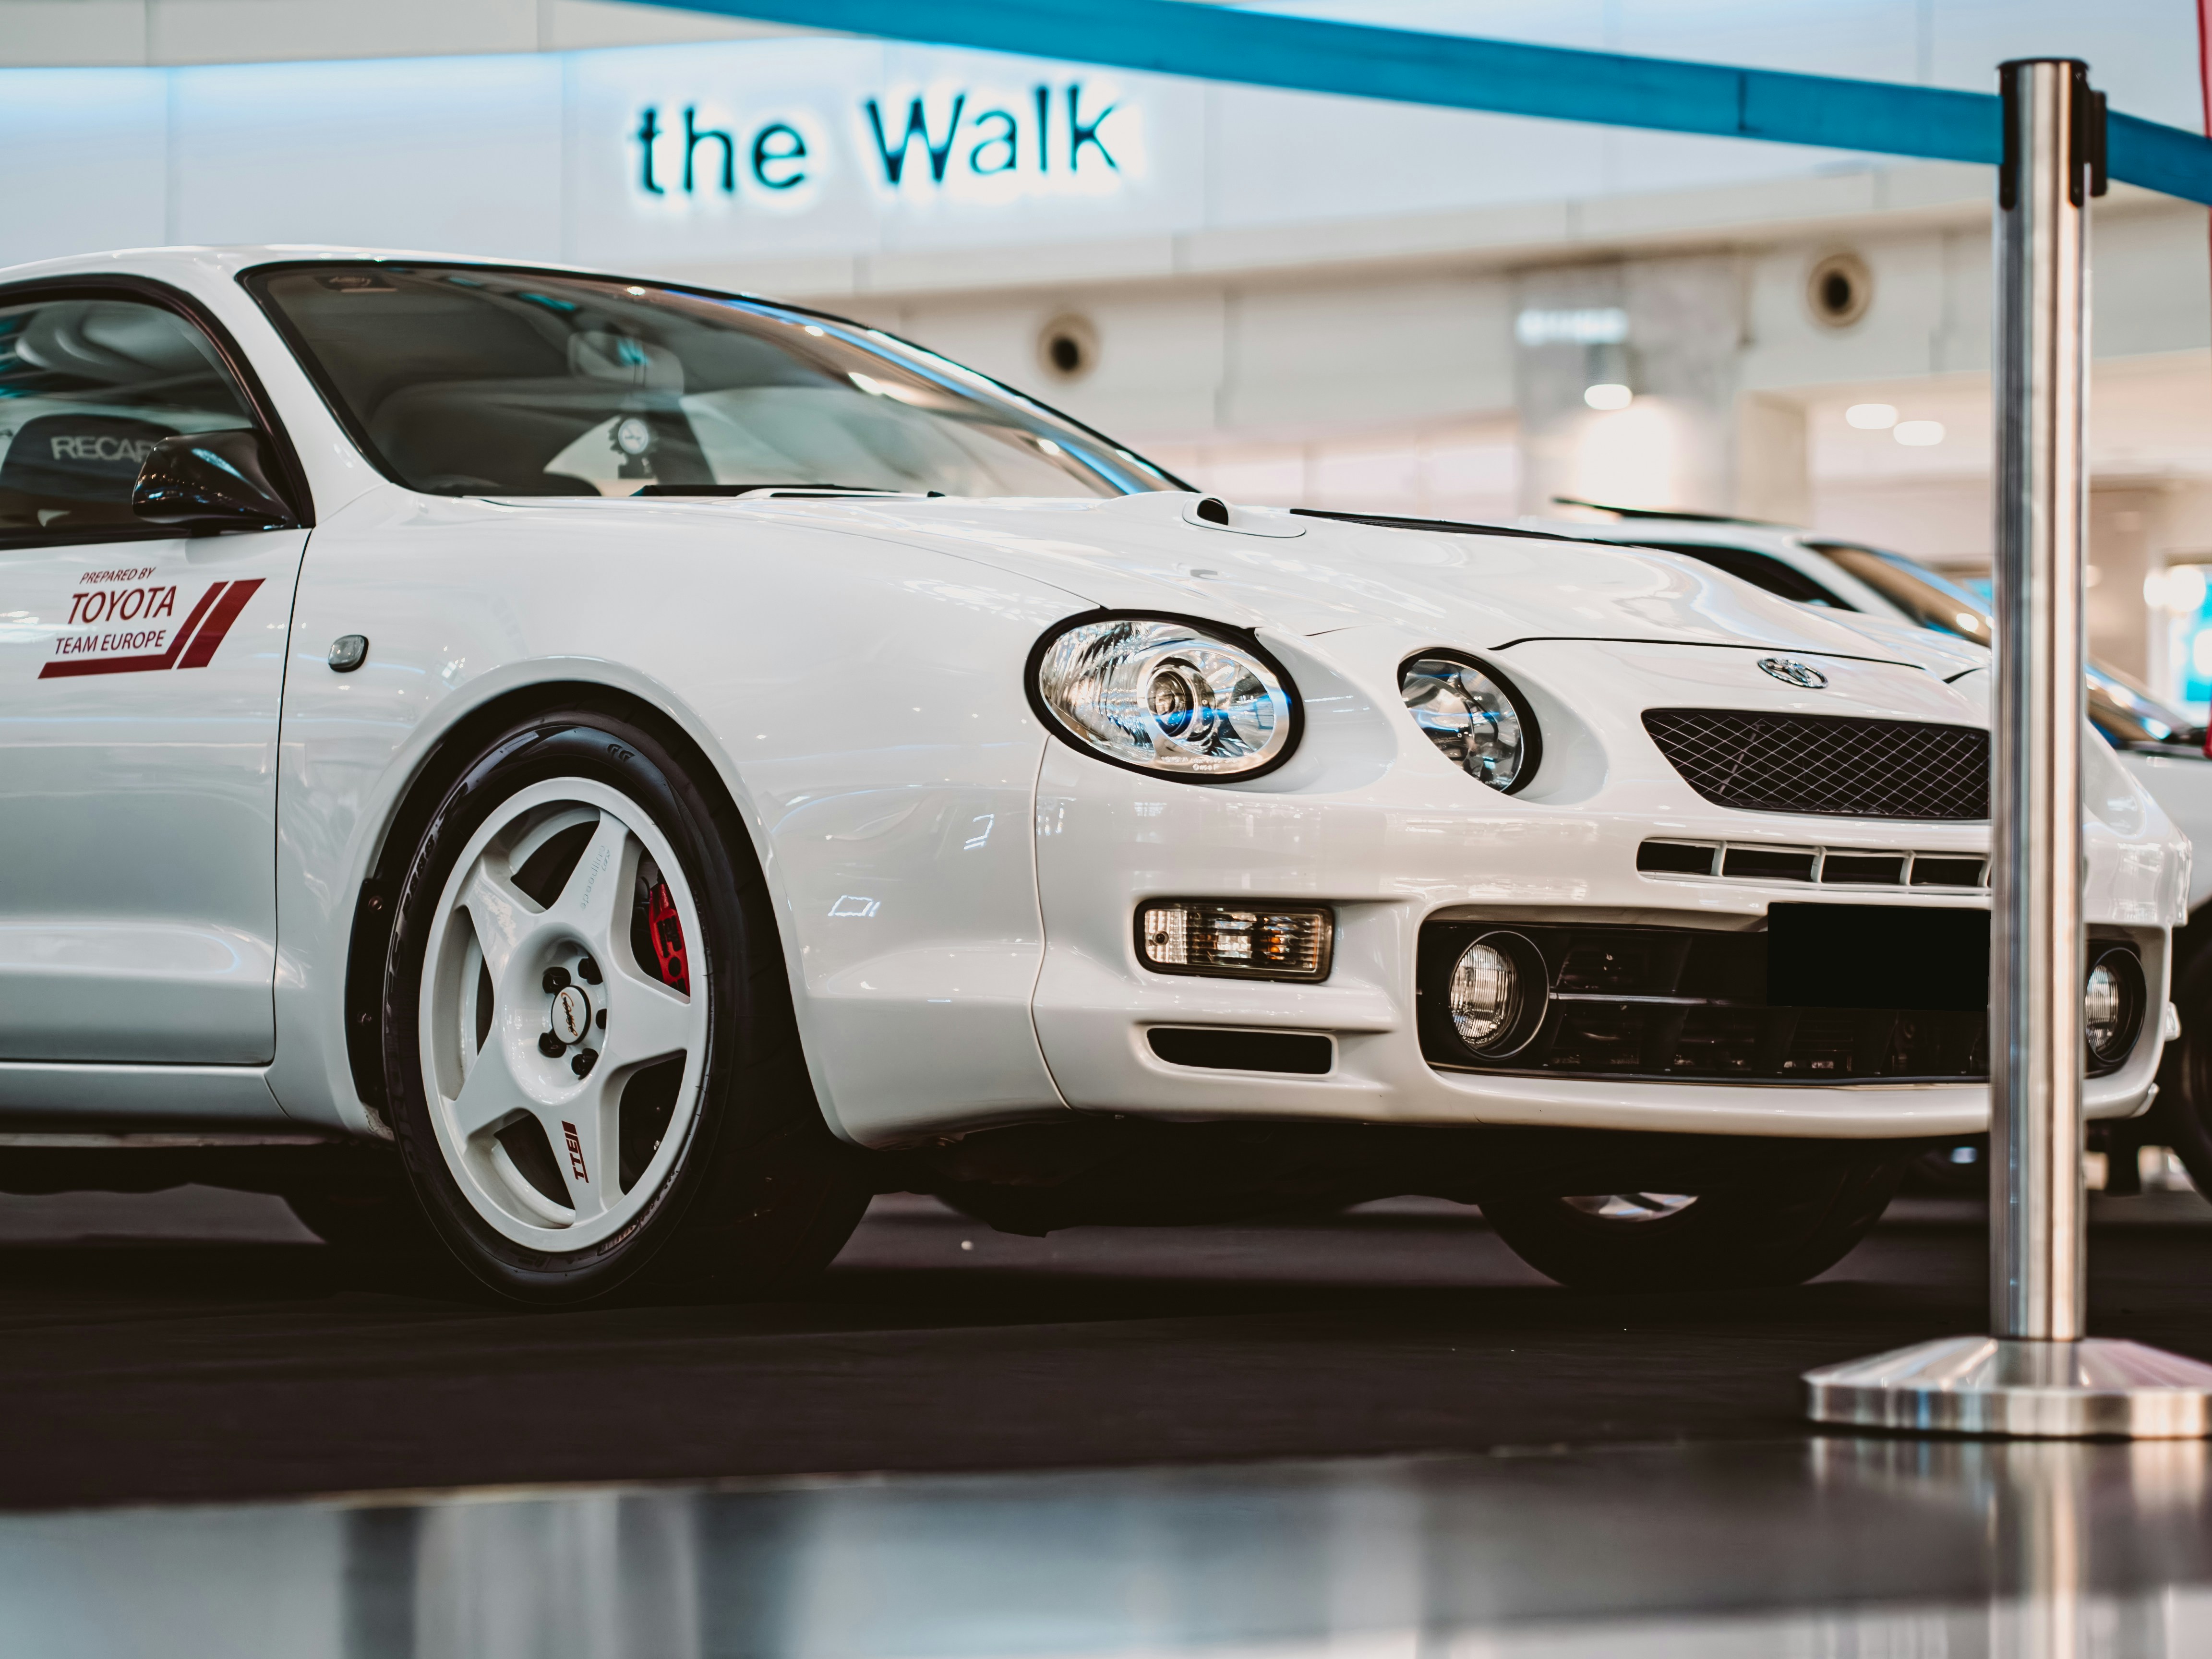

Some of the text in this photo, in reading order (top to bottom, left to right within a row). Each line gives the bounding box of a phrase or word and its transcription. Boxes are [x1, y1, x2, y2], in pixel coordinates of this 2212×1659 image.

[635, 84, 1119, 194] the Walk
[50, 436, 154, 463] RECAR
[80, 567, 156, 584] PREPARED BY
[68, 585, 177, 624] TOYOTA
[55, 630, 166, 654] TEAM EUROPE
